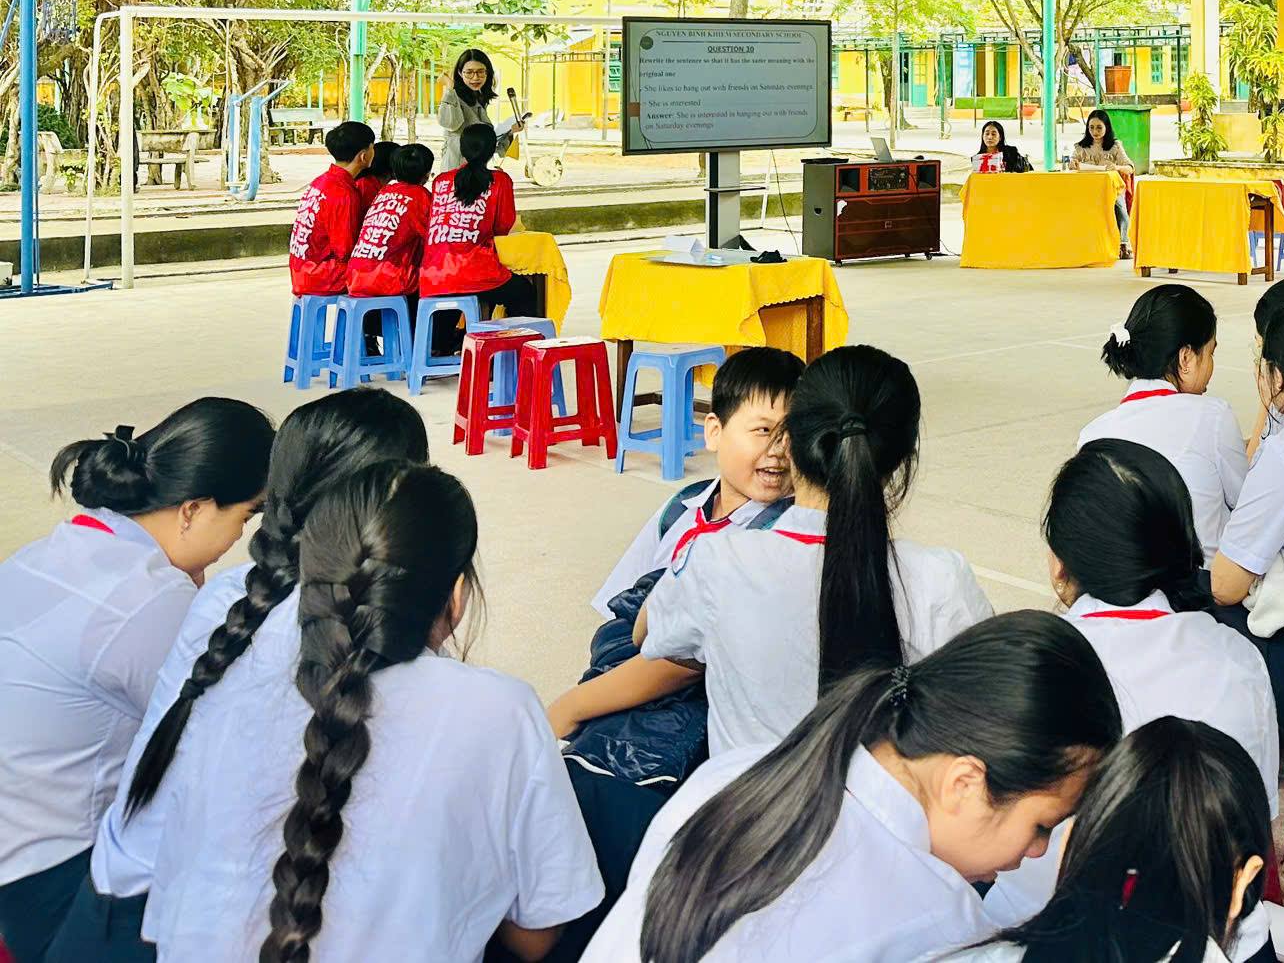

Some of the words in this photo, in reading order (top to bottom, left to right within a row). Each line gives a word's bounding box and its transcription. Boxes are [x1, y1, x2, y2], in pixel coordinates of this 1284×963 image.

[707, 45, 744, 53] QUESTION
[658, 84, 674, 92] likes
[683, 84, 699, 93] hang
[713, 84, 727, 92] with
[728, 83, 749, 91] friends
[759, 83, 785, 92] Saturday
[648, 99, 660, 107] She
[670, 98, 701, 107] interested
[676, 111, 689, 119] She
[697, 110, 728, 118] interested
[736, 109, 761, 119] hanging
[774, 109, 787, 117] with
[788, 108, 808, 116] friends
[655, 122, 684, 130] Saturday
[449, 211, 484, 230] SET
[363, 226, 395, 246] SET
[427, 224, 481, 246] THEM
